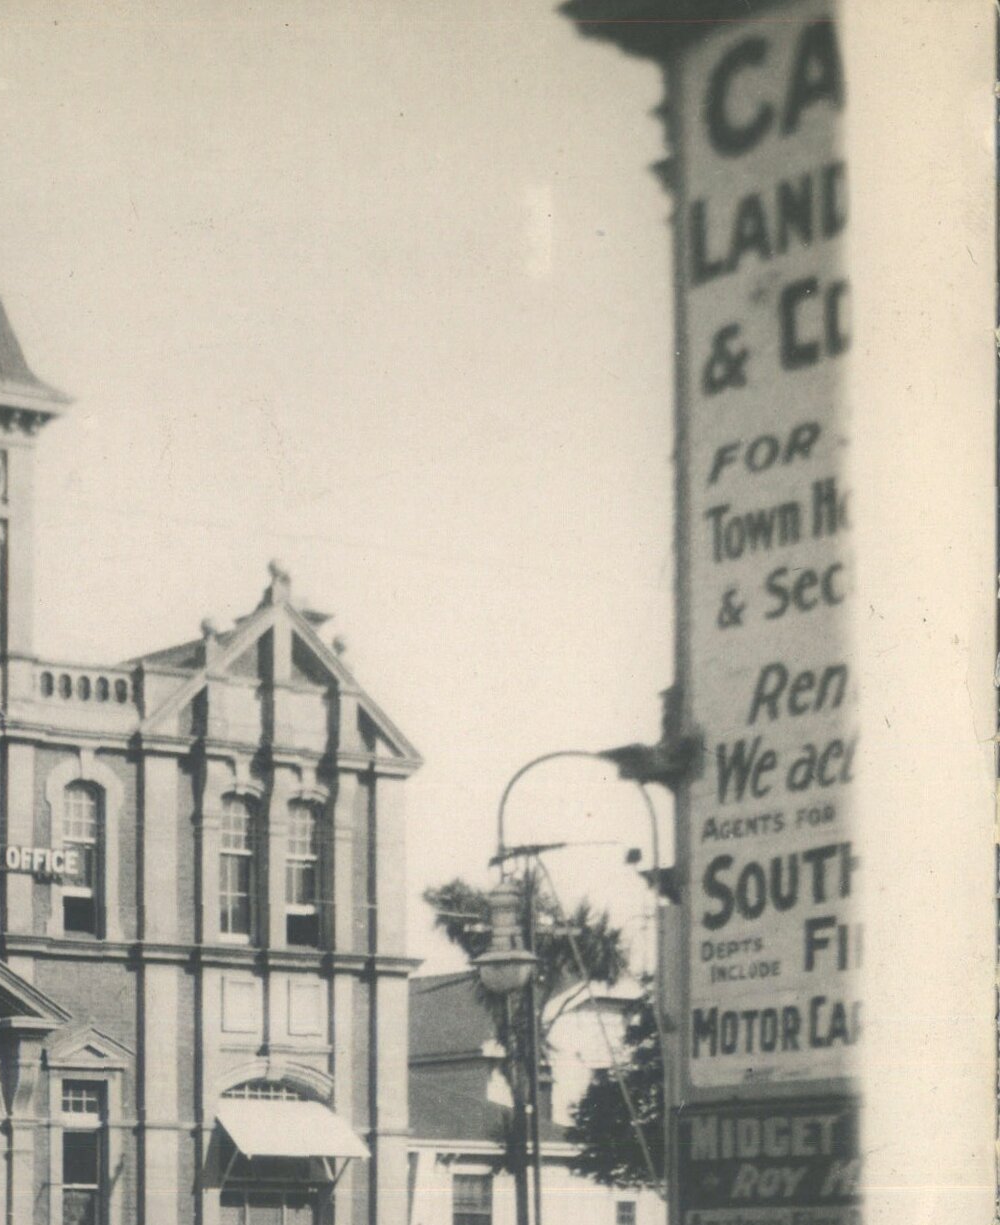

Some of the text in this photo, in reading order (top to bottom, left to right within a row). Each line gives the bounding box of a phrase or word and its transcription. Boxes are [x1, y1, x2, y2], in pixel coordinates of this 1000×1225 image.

[702, 323, 749, 397] &
[708, 421, 821, 486] FOR
[717, 587, 746, 630] &
[715, 734, 777, 804] We
[702, 805, 837, 841] AGENTS FOR
[6, 846, 80, 875] OFFICE
[710, 960, 782, 983] INCLUDE
[692, 1004, 802, 1060] MOTOR
[689, 1114, 838, 1161] MIDGET
